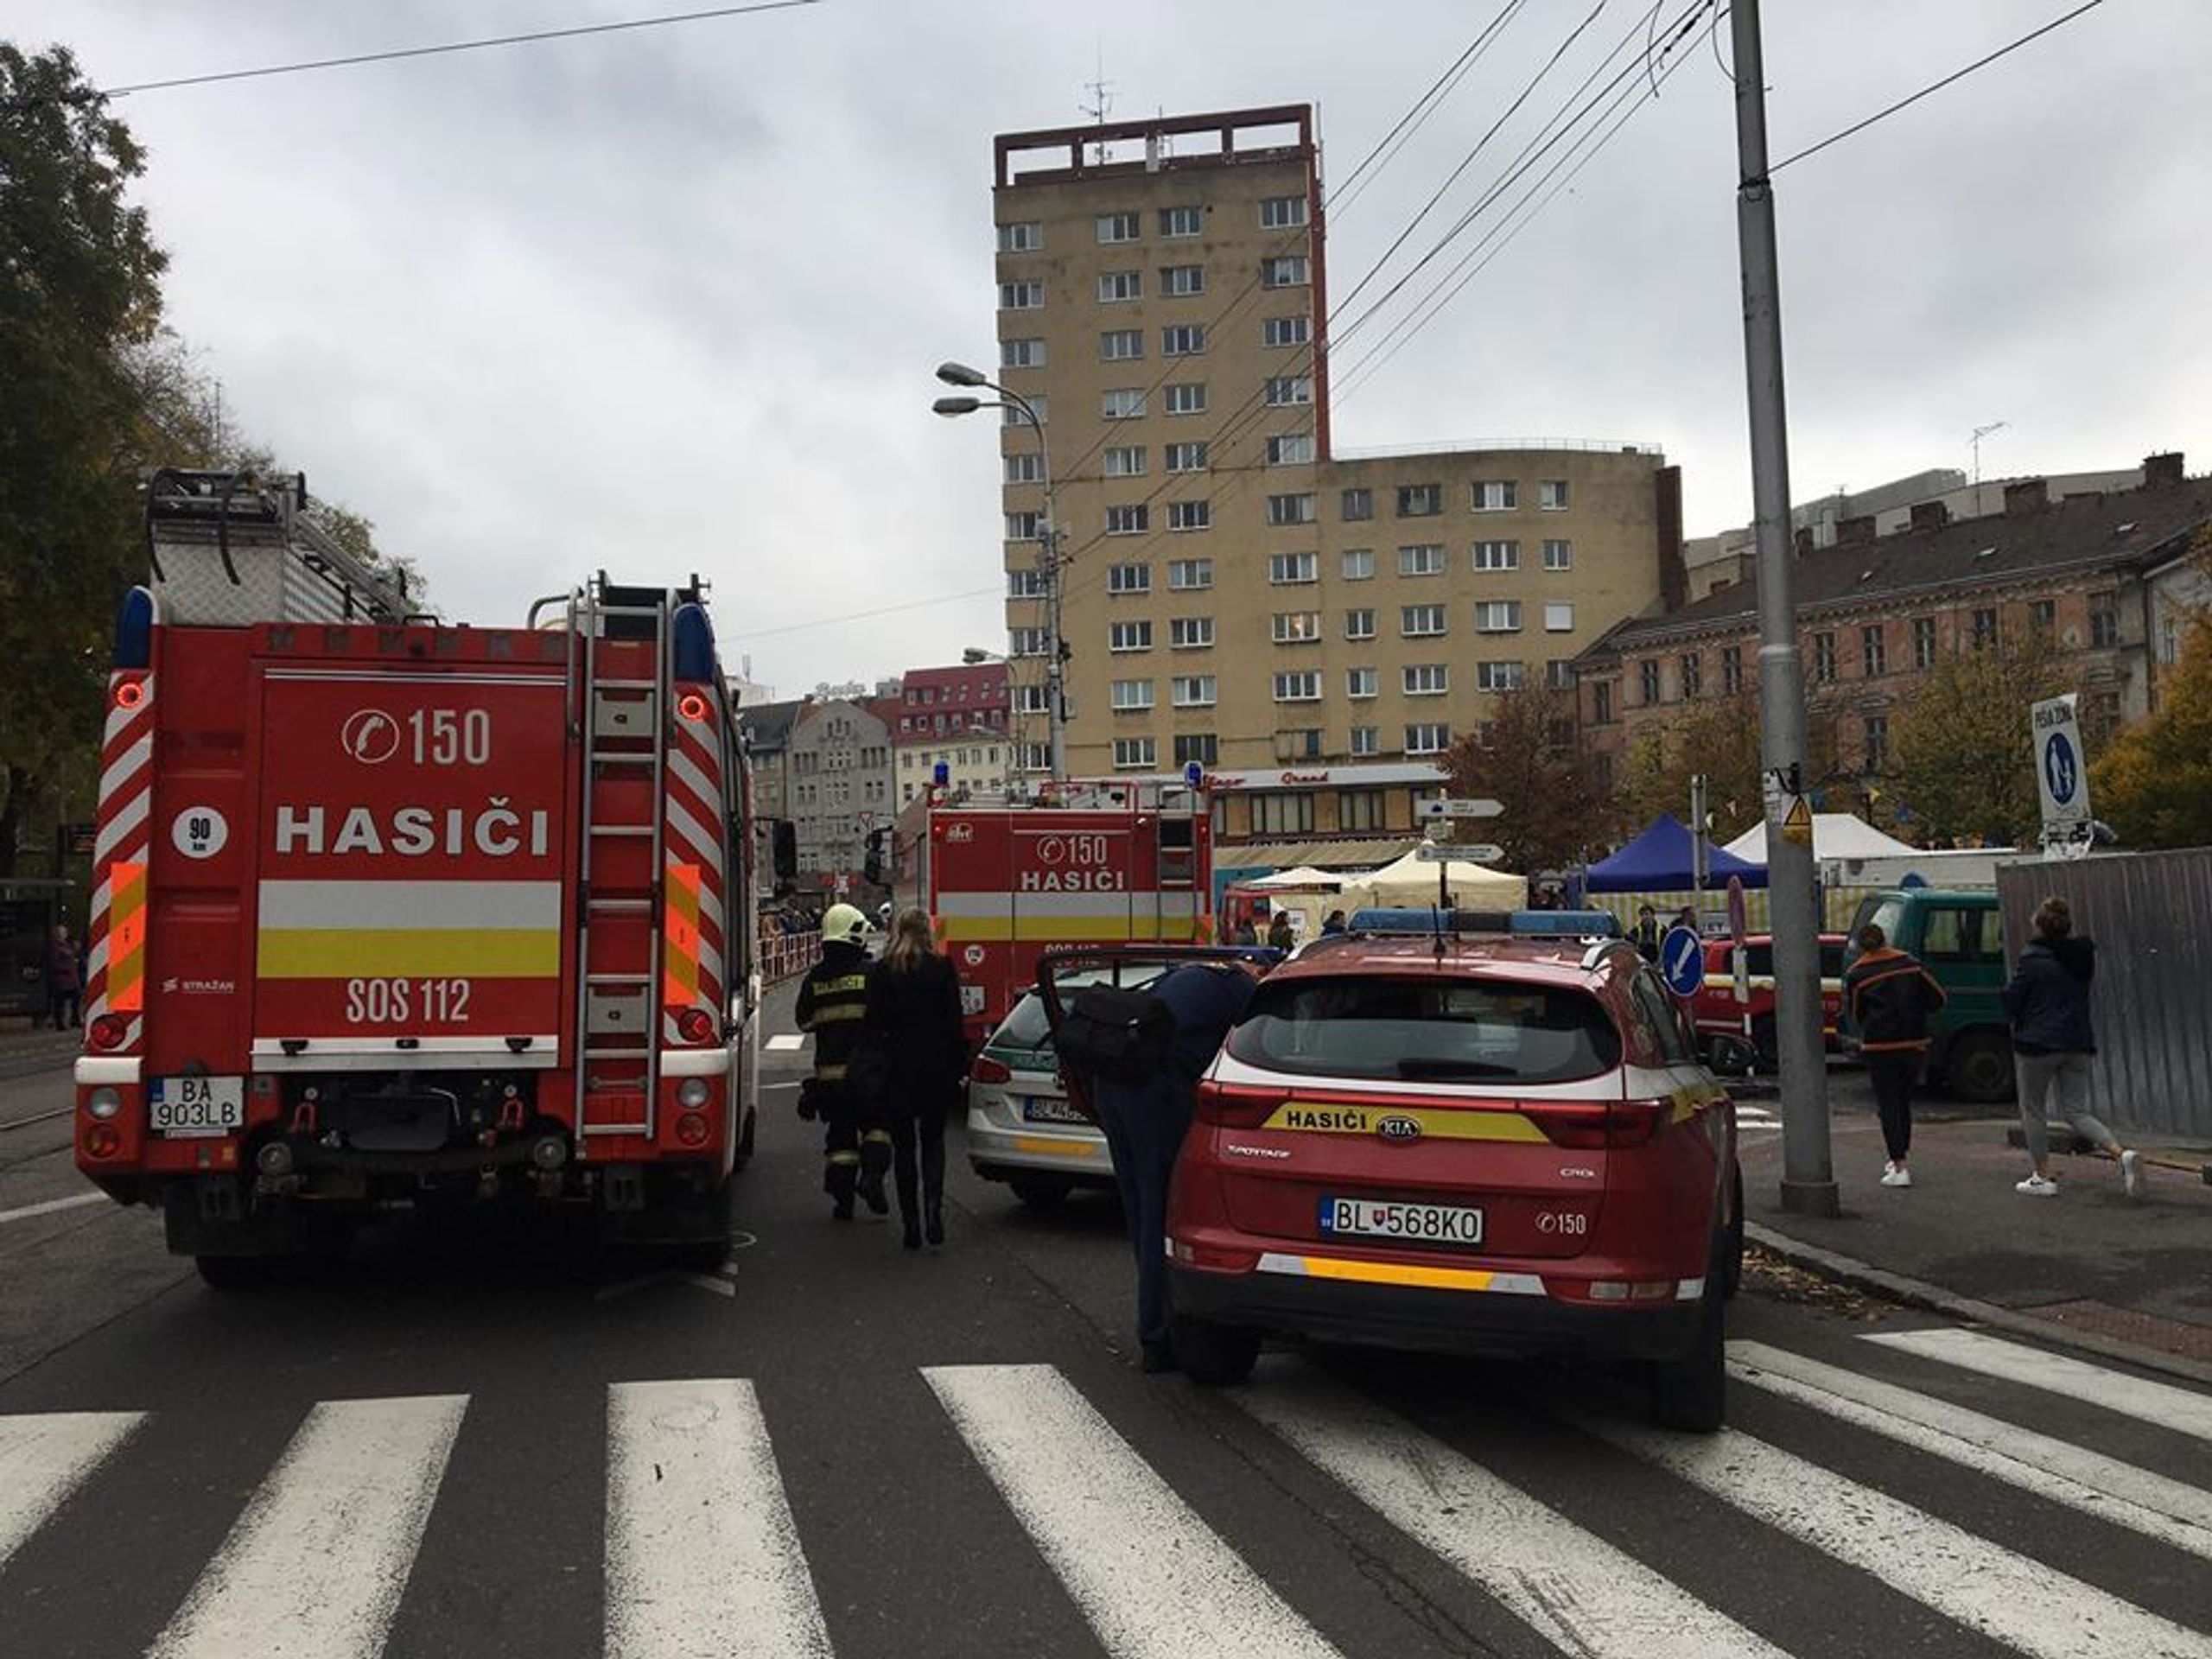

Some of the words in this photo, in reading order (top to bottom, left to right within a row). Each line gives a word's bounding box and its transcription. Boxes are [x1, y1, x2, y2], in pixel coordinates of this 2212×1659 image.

[408, 709, 490, 766] 150
[189, 817, 210, 840] 90
[276, 796, 549, 856] HASIČI
[1068, 836, 1108, 865] 150
[1020, 866, 1124, 891] HASIČI
[346, 978, 410, 1023] SOS
[419, 978, 470, 1022] 112
[182, 1080, 213, 1103] BA
[158, 1102, 236, 1126] 903LB
[1286, 1109, 1367, 1130] HASIČI
[1383, 1121, 1414, 1135] KIA
[1337, 1202, 1370, 1231] BL
[1386, 1205, 1479, 1240] 568KO
[1558, 1213, 1586, 1235] 150
